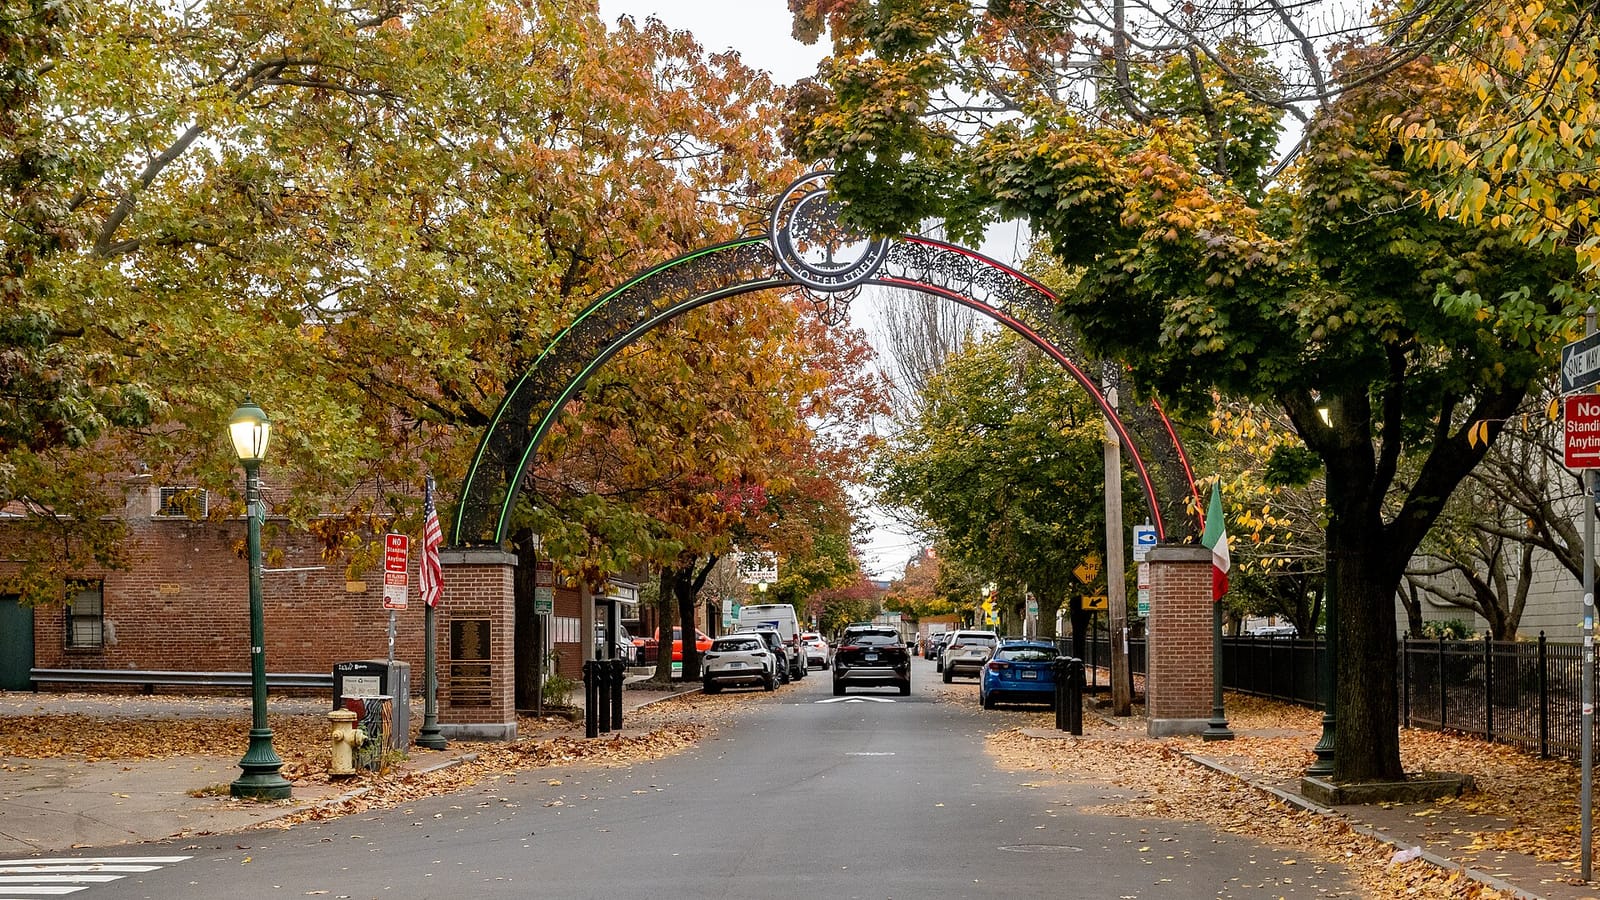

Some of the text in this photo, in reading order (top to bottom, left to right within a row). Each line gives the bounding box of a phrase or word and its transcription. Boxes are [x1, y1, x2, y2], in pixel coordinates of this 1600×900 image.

[843, 250, 877, 282] STREET
[1568, 347, 1599, 377] ONE WAY
[1577, 402, 1600, 417] No
[1567, 419, 1600, 433] Standi
